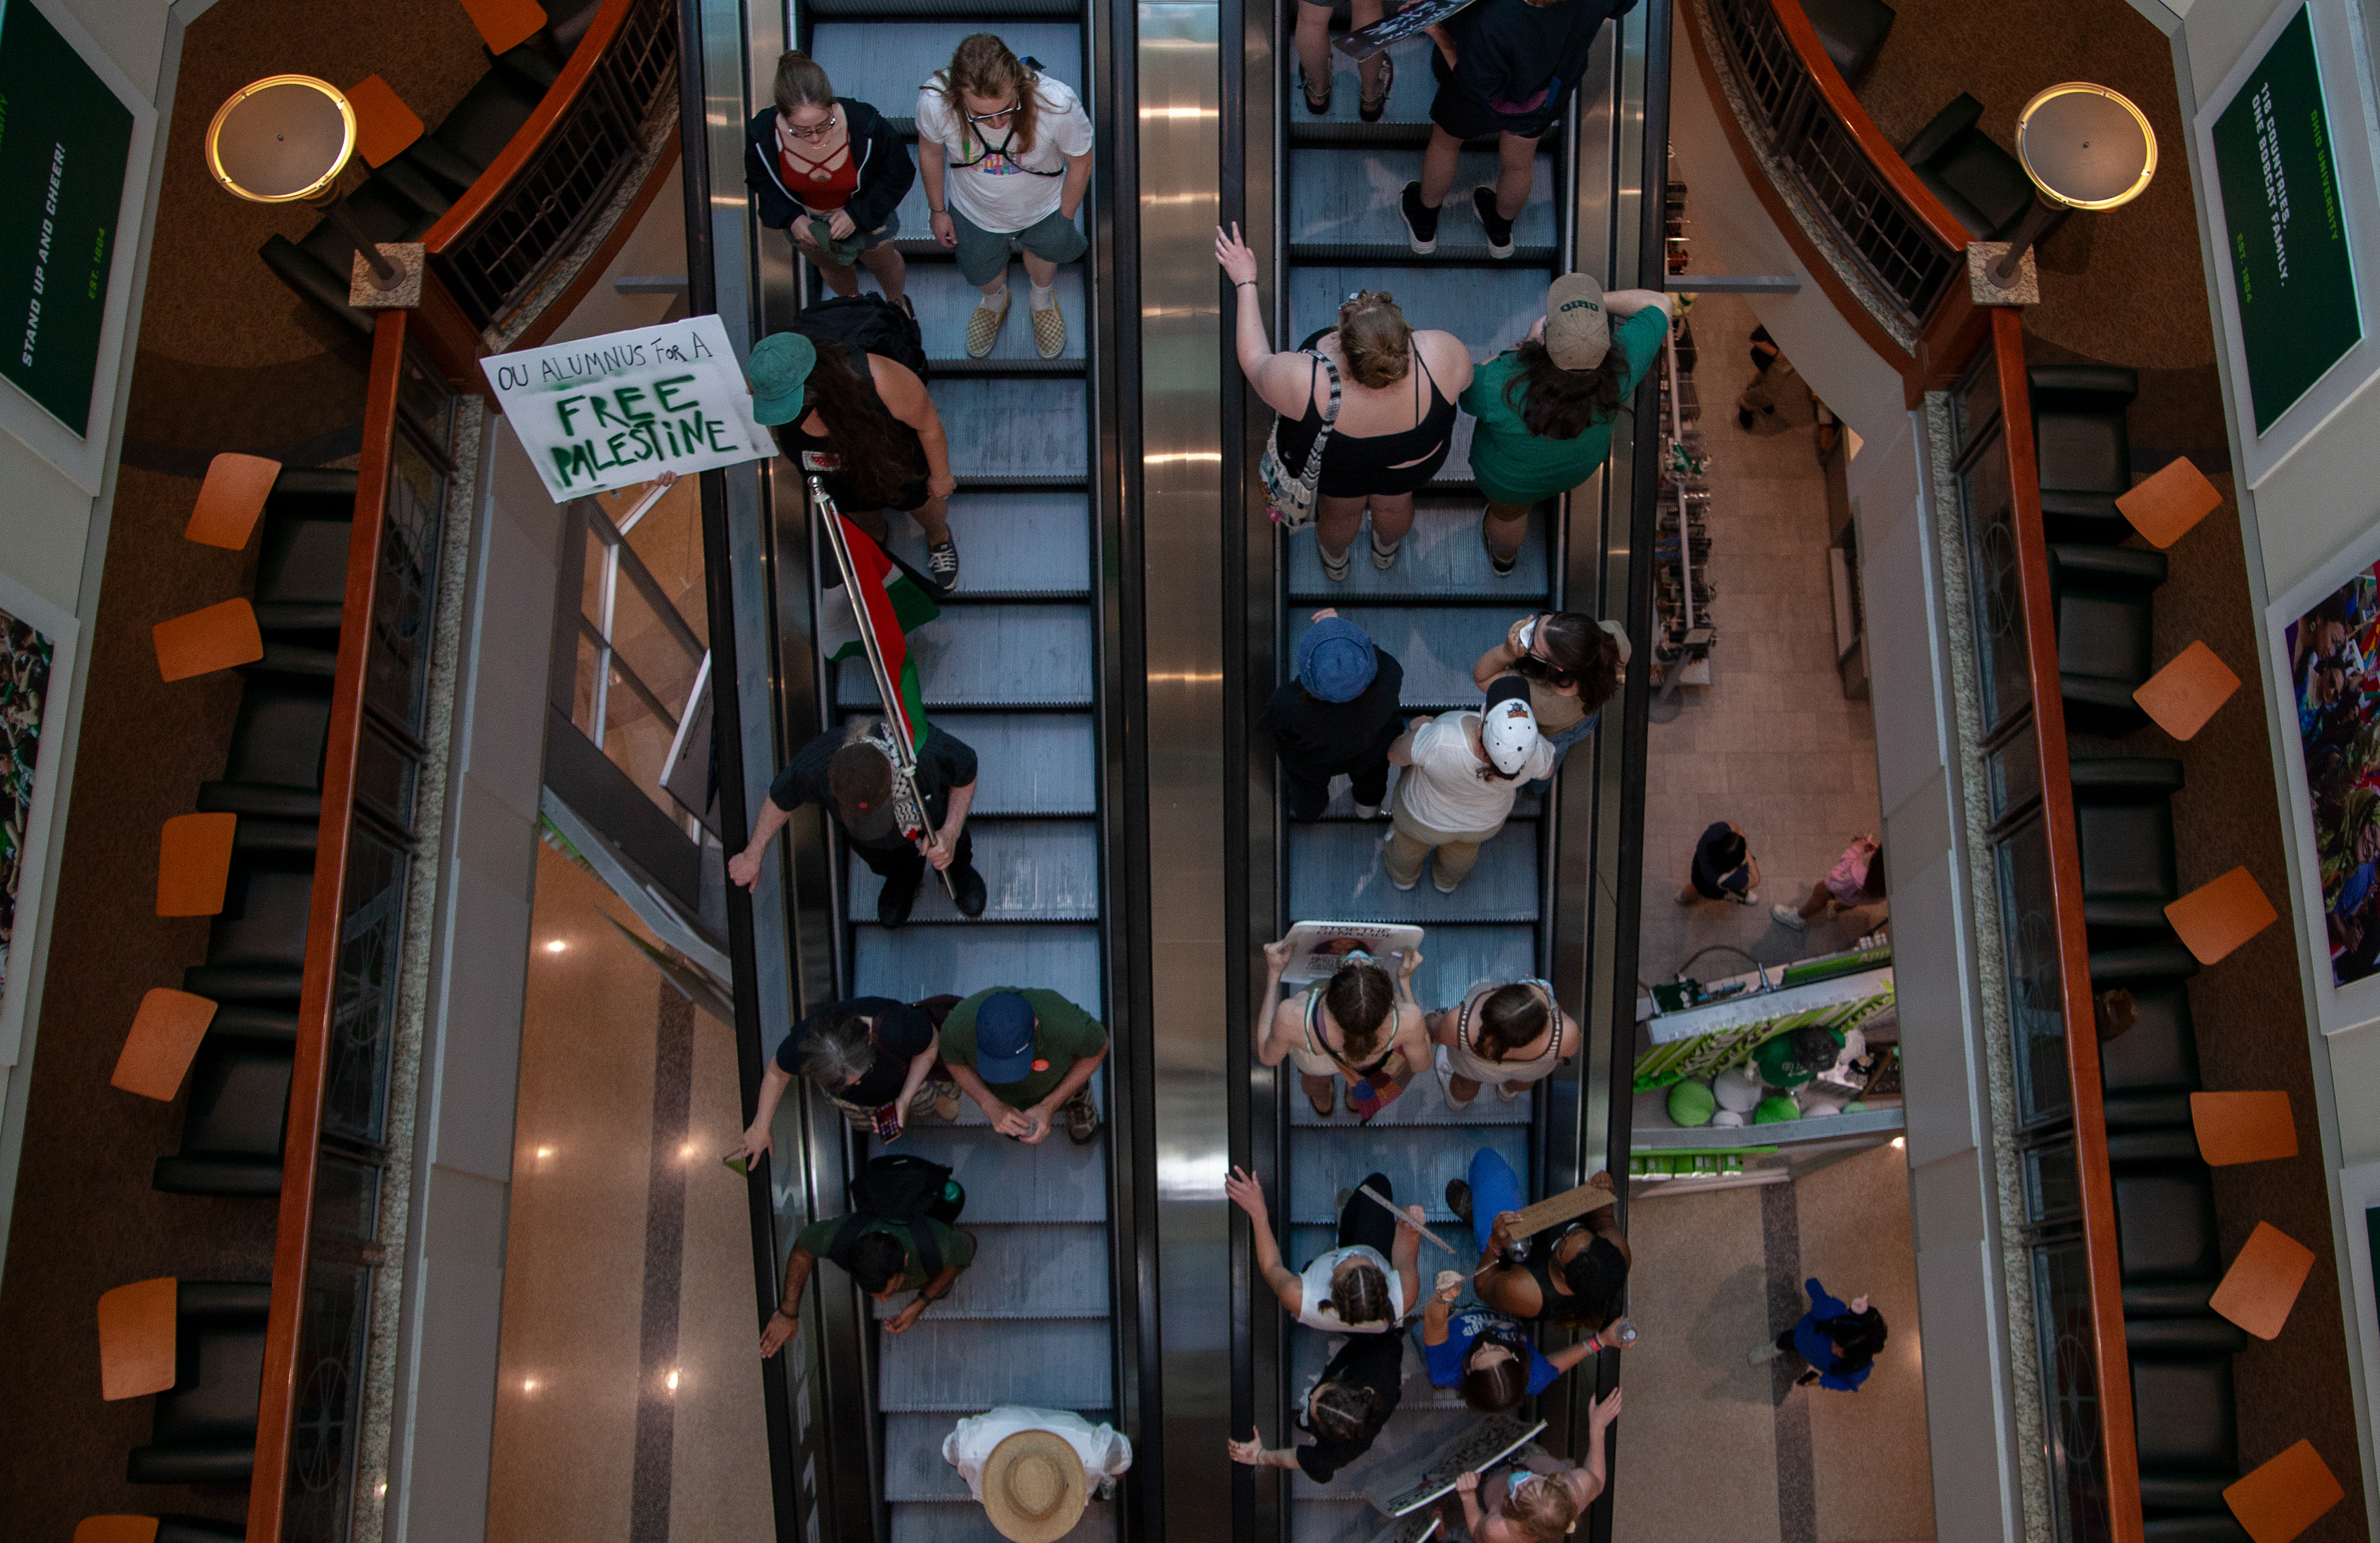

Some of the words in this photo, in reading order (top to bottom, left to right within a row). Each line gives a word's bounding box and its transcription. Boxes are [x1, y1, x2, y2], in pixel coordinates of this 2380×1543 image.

[46, 143, 65, 215] CHEER!
[2252, 94, 2265, 134] ONE
[2259, 135, 2278, 208] BOBCAT
[2272, 211, 2288, 287] FAMILY.
[2267, 116, 2290, 229] COUNTRIES.
[2310, 109, 2322, 147] OHIO
[2317, 149, 2338, 240] UNIVERSITY
[38, 219, 52, 263] AND
[88, 271, 99, 301] EST.
[94, 227, 105, 263] 1804
[33, 265, 45, 295] UP
[1559, 299, 1600, 314] OHIO
[22, 299, 40, 367] STAND
[498, 366, 529, 390] OU
[542, 344, 646, 382] ALUMNUS
[692, 332, 713, 358] A
[557, 374, 700, 436] FREE
